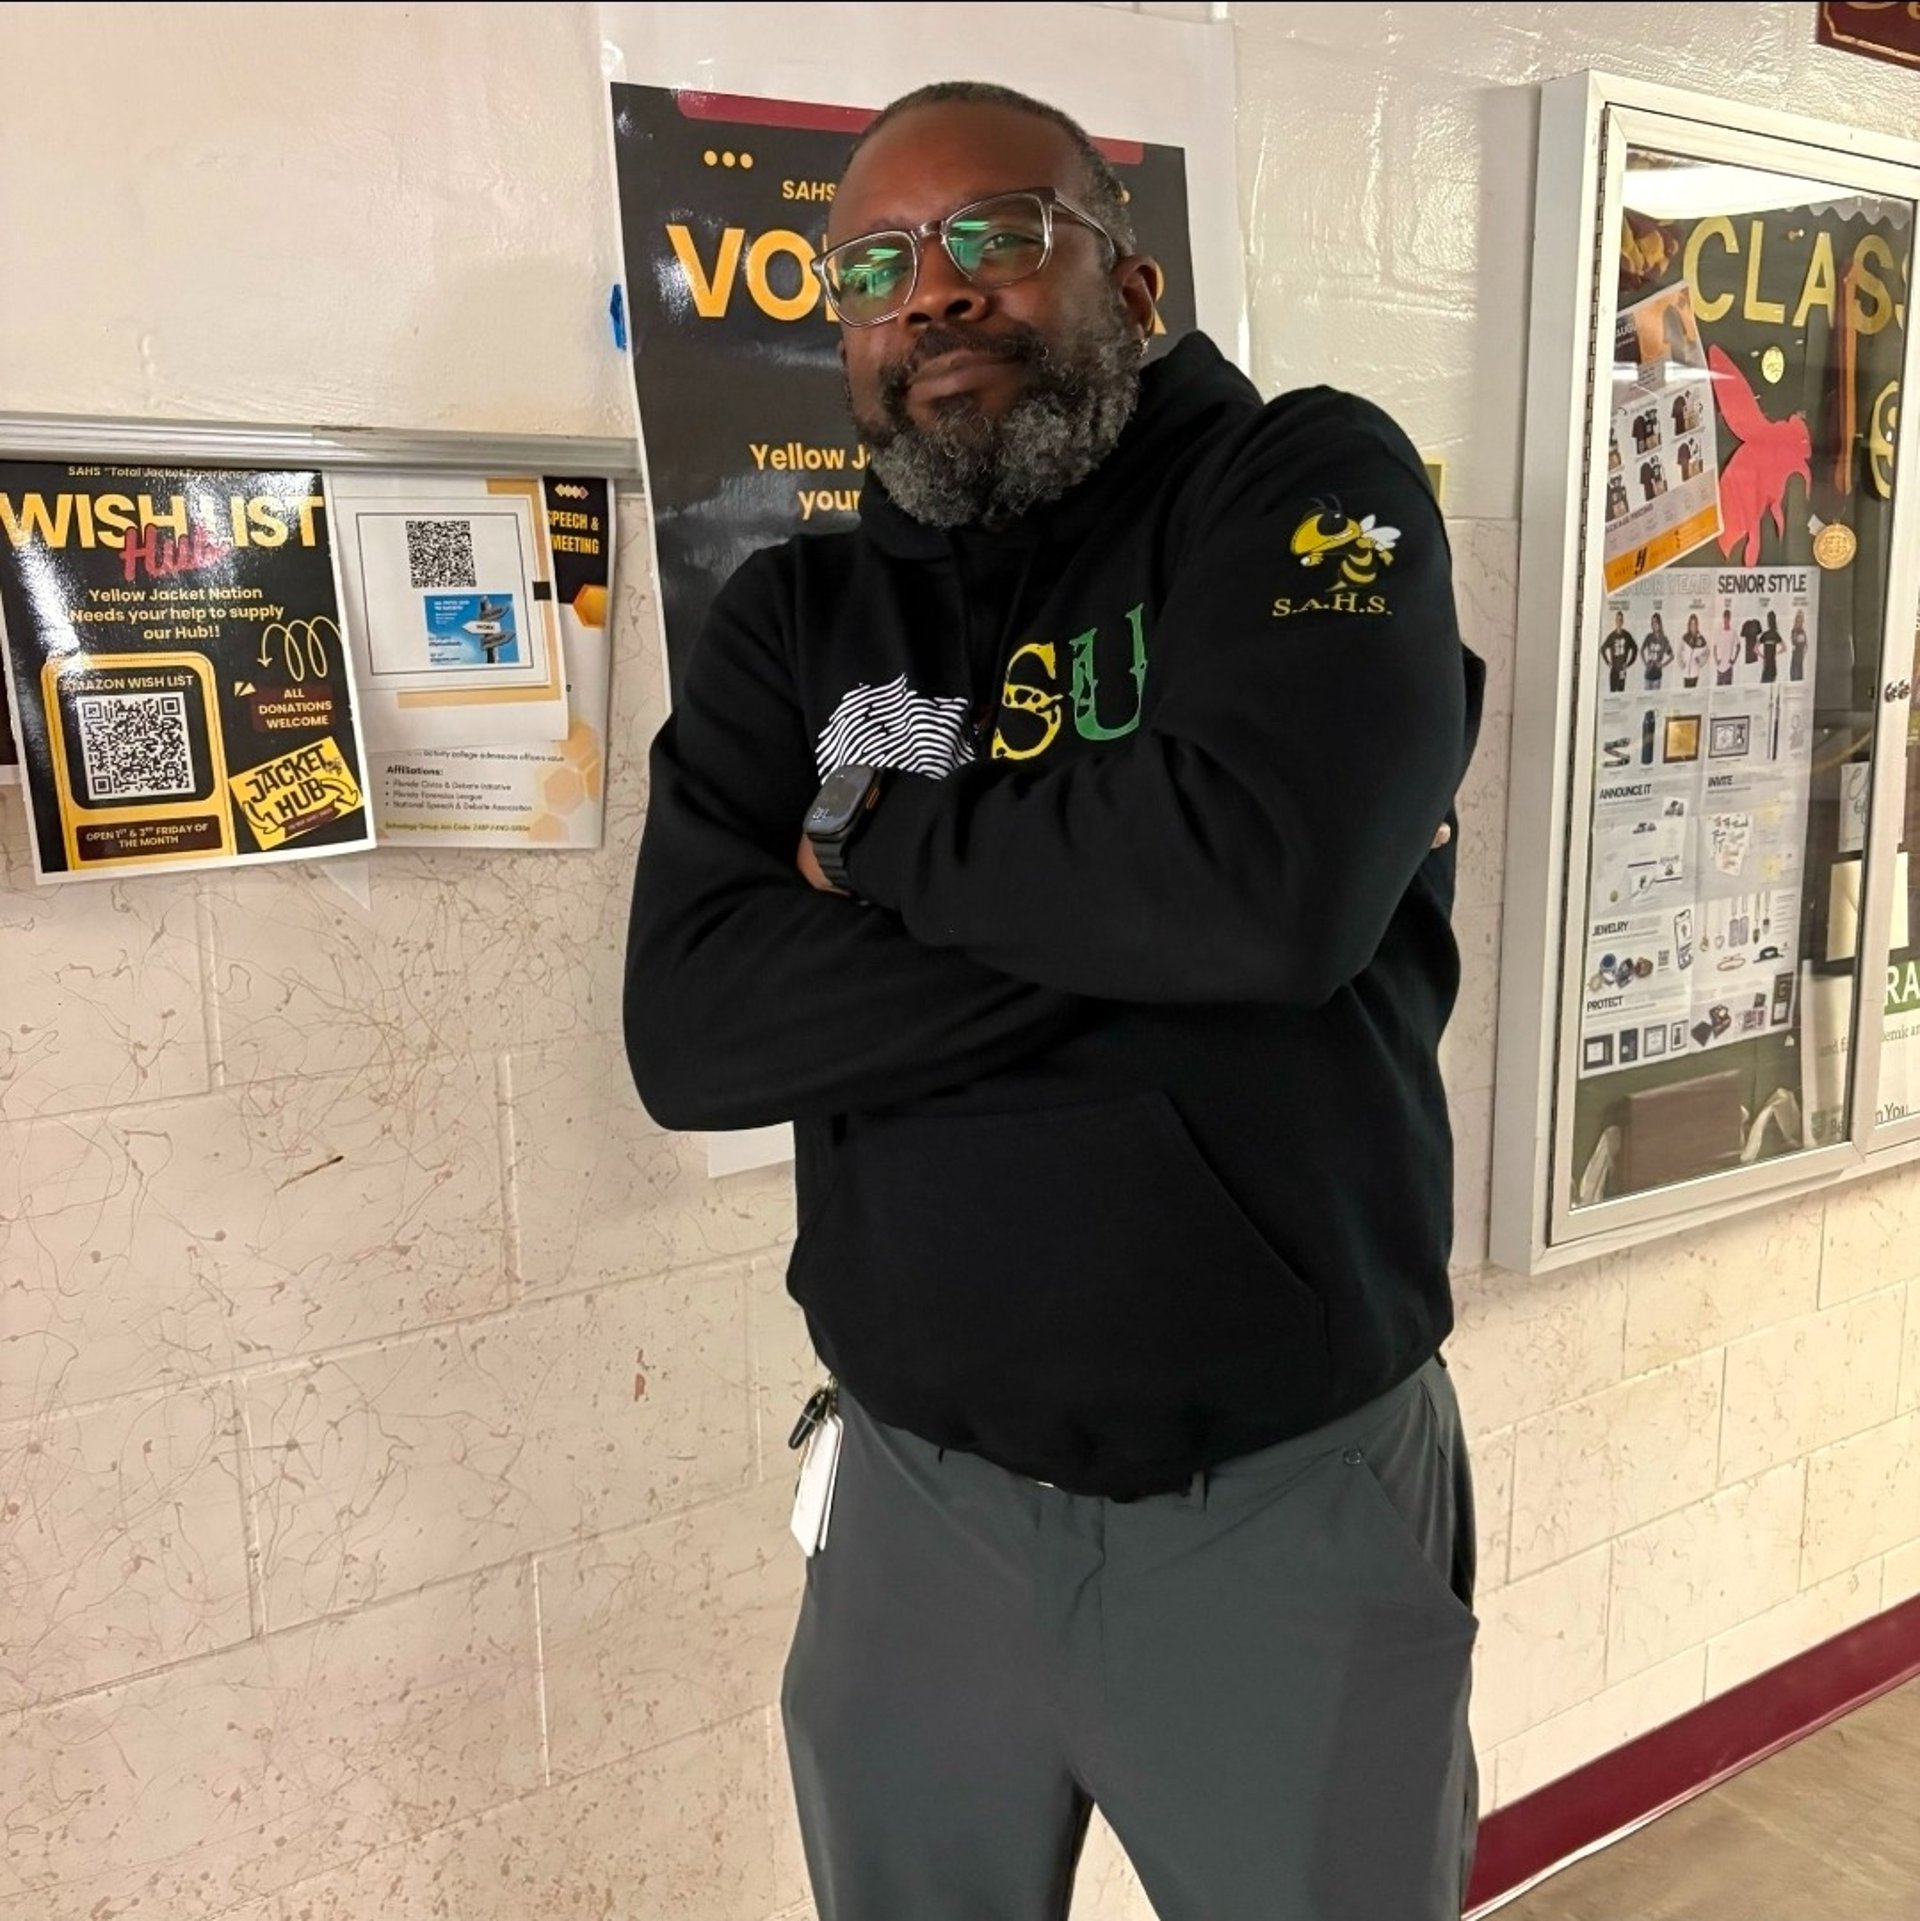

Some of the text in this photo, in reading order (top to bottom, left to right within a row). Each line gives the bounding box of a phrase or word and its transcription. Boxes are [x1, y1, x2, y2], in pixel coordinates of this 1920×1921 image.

[782, 180, 836, 202] SAHS
[665, 224, 841, 322] VO
[749, 442, 871, 471] Yellow J
[68, 466, 101, 477] SAHS
[798, 490, 861, 521] your
[0, 492, 324, 549] WISH LIST
[547, 510, 599, 531] SPEECH &
[119, 520, 229, 582] Hub
[551, 534, 600, 555] MEETING
[89, 586, 263, 602] Yellow Jacket Nation
[1718, 574, 1763, 594] SENIOR
[1768, 574, 1807, 593] STYLE
[1272, 591, 1393, 617] S.A.H.S.
[70, 604, 284, 626] Needs your help to supply
[143, 625, 221, 640] our Hub!!
[59, 674, 194, 692] AMAZON WISH LIST
[283, 688, 305, 700] ALL
[258, 700, 332, 715] DONATIONS
[265, 715, 329, 729] WELCOME
[244, 743, 327, 804] JACKET
[387, 764, 444, 776] Affiliations:
[1708, 775, 1734, 788] INVITE
[274, 777, 326, 819] HUB
[1599, 786, 1643, 800] ANNOUNCE
[86, 831, 116, 842] OPEN
[129, 828, 138, 838] &
[155, 824, 193, 836] FRIDAY
[194, 822, 209, 833] OF
[118, 836, 179, 849] THE MONTH
[1592, 921, 1629, 937] JEWELRY
[1586, 996, 1624, 1012] PROTECT
